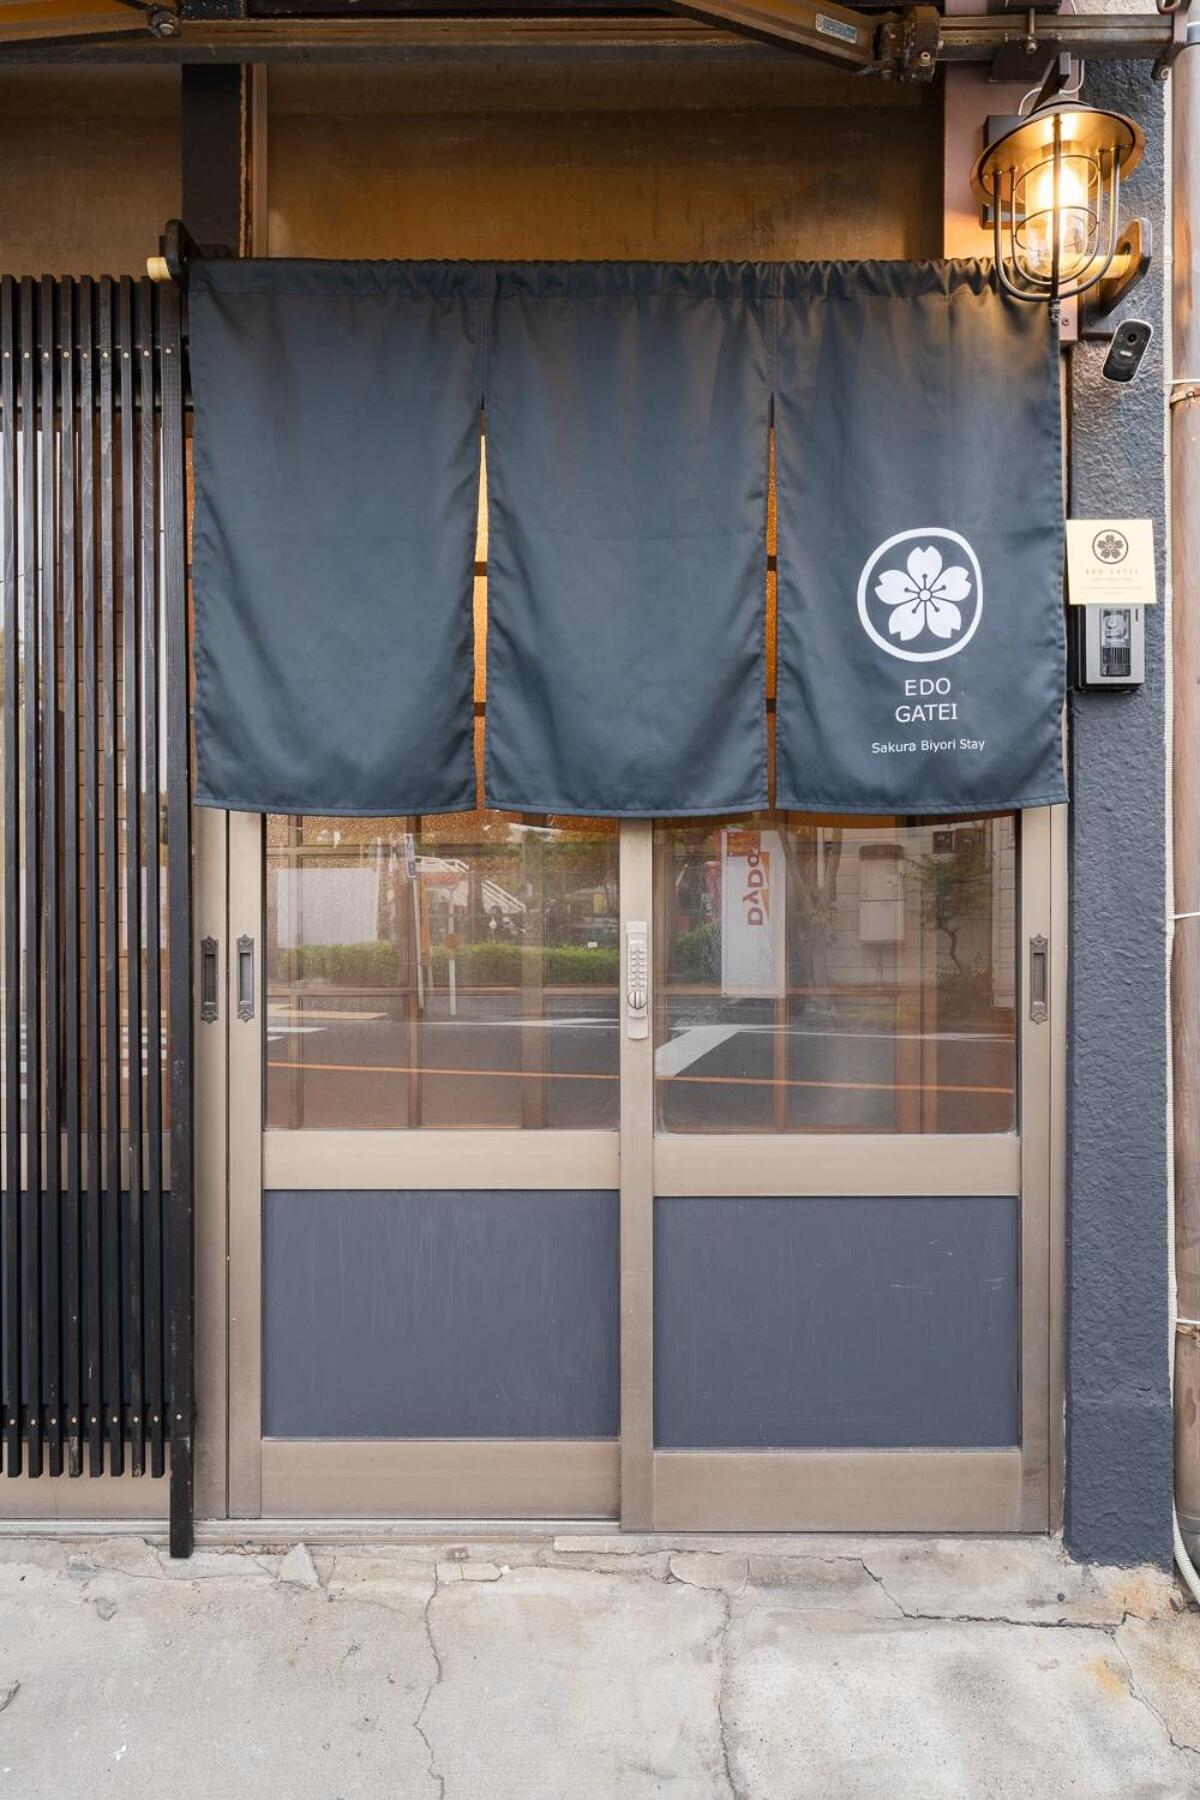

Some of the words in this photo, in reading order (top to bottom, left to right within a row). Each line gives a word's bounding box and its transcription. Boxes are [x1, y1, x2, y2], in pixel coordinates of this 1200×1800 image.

[905, 677, 951, 696] EDO
[895, 703, 958, 722] GATEI
[871, 742, 917, 754] Sakura
[921, 738, 956, 753] Biyori
[959, 738, 985, 752] Stay
